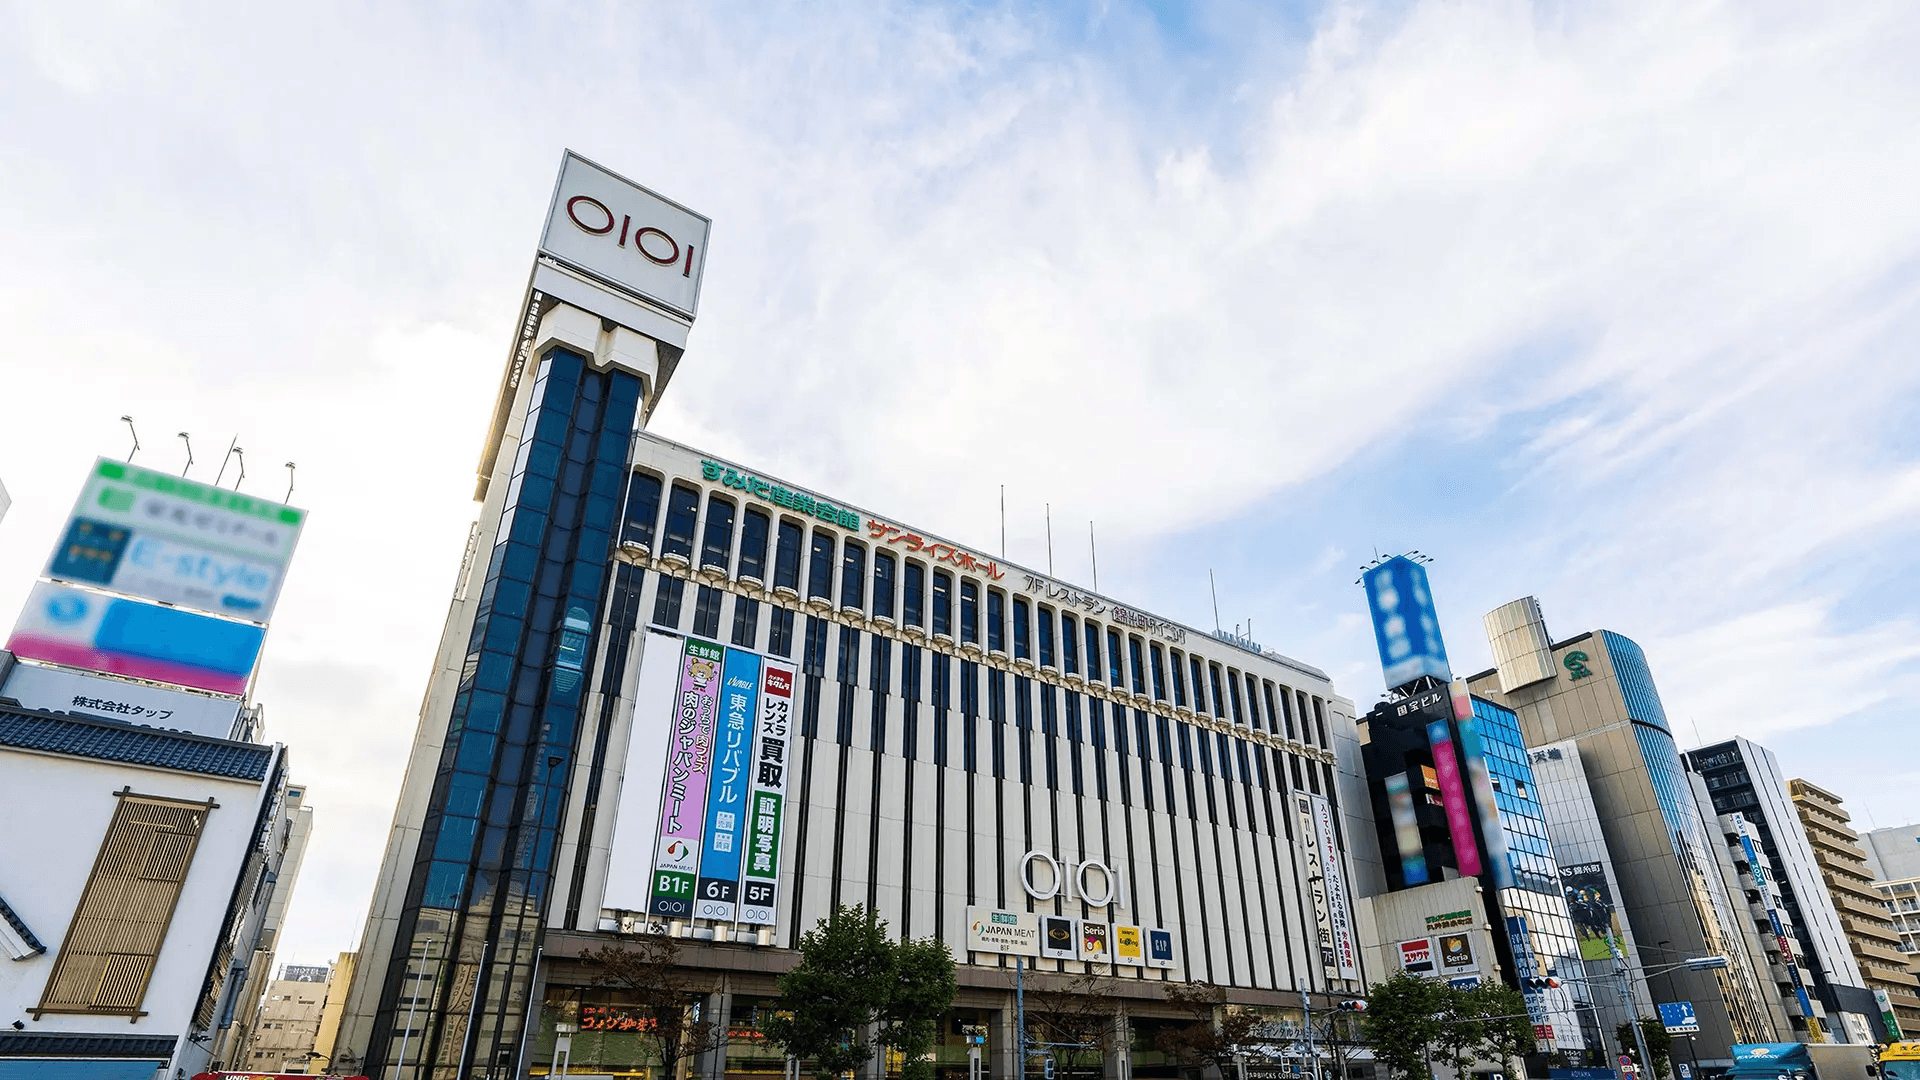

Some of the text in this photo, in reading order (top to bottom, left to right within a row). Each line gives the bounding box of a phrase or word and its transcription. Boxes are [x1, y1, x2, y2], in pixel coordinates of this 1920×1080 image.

[701, 459, 860, 531] すみだ産業会館
[1024, 575, 1044, 593] 7F
[1047, 583, 1106, 614] レストラン
[689, 644, 720, 661] 生鮮館
[767, 679, 790, 690] キタムラ
[72, 695, 173, 720] 株式会社タップ
[763, 698, 776, 734] レンズ
[1397, 692, 1442, 717] 国宝ビル
[775, 701, 788, 736] カメラ
[718, 693, 748, 803] 東急リバブル
[667, 691, 699, 834] 肉のジャパンミート
[757, 736, 785, 789] 買取
[753, 797, 776, 872] 証明写真
[1560, 866, 1573, 876] NS
[658, 875, 690, 893] B1F
[706, 881, 729, 899] 6F
[748, 887, 771, 901] 5F
[985, 925, 1035, 938] JAPAN MEAT
[1084, 925, 1105, 936] Seria
[1447, 953, 1468, 963] Seria
